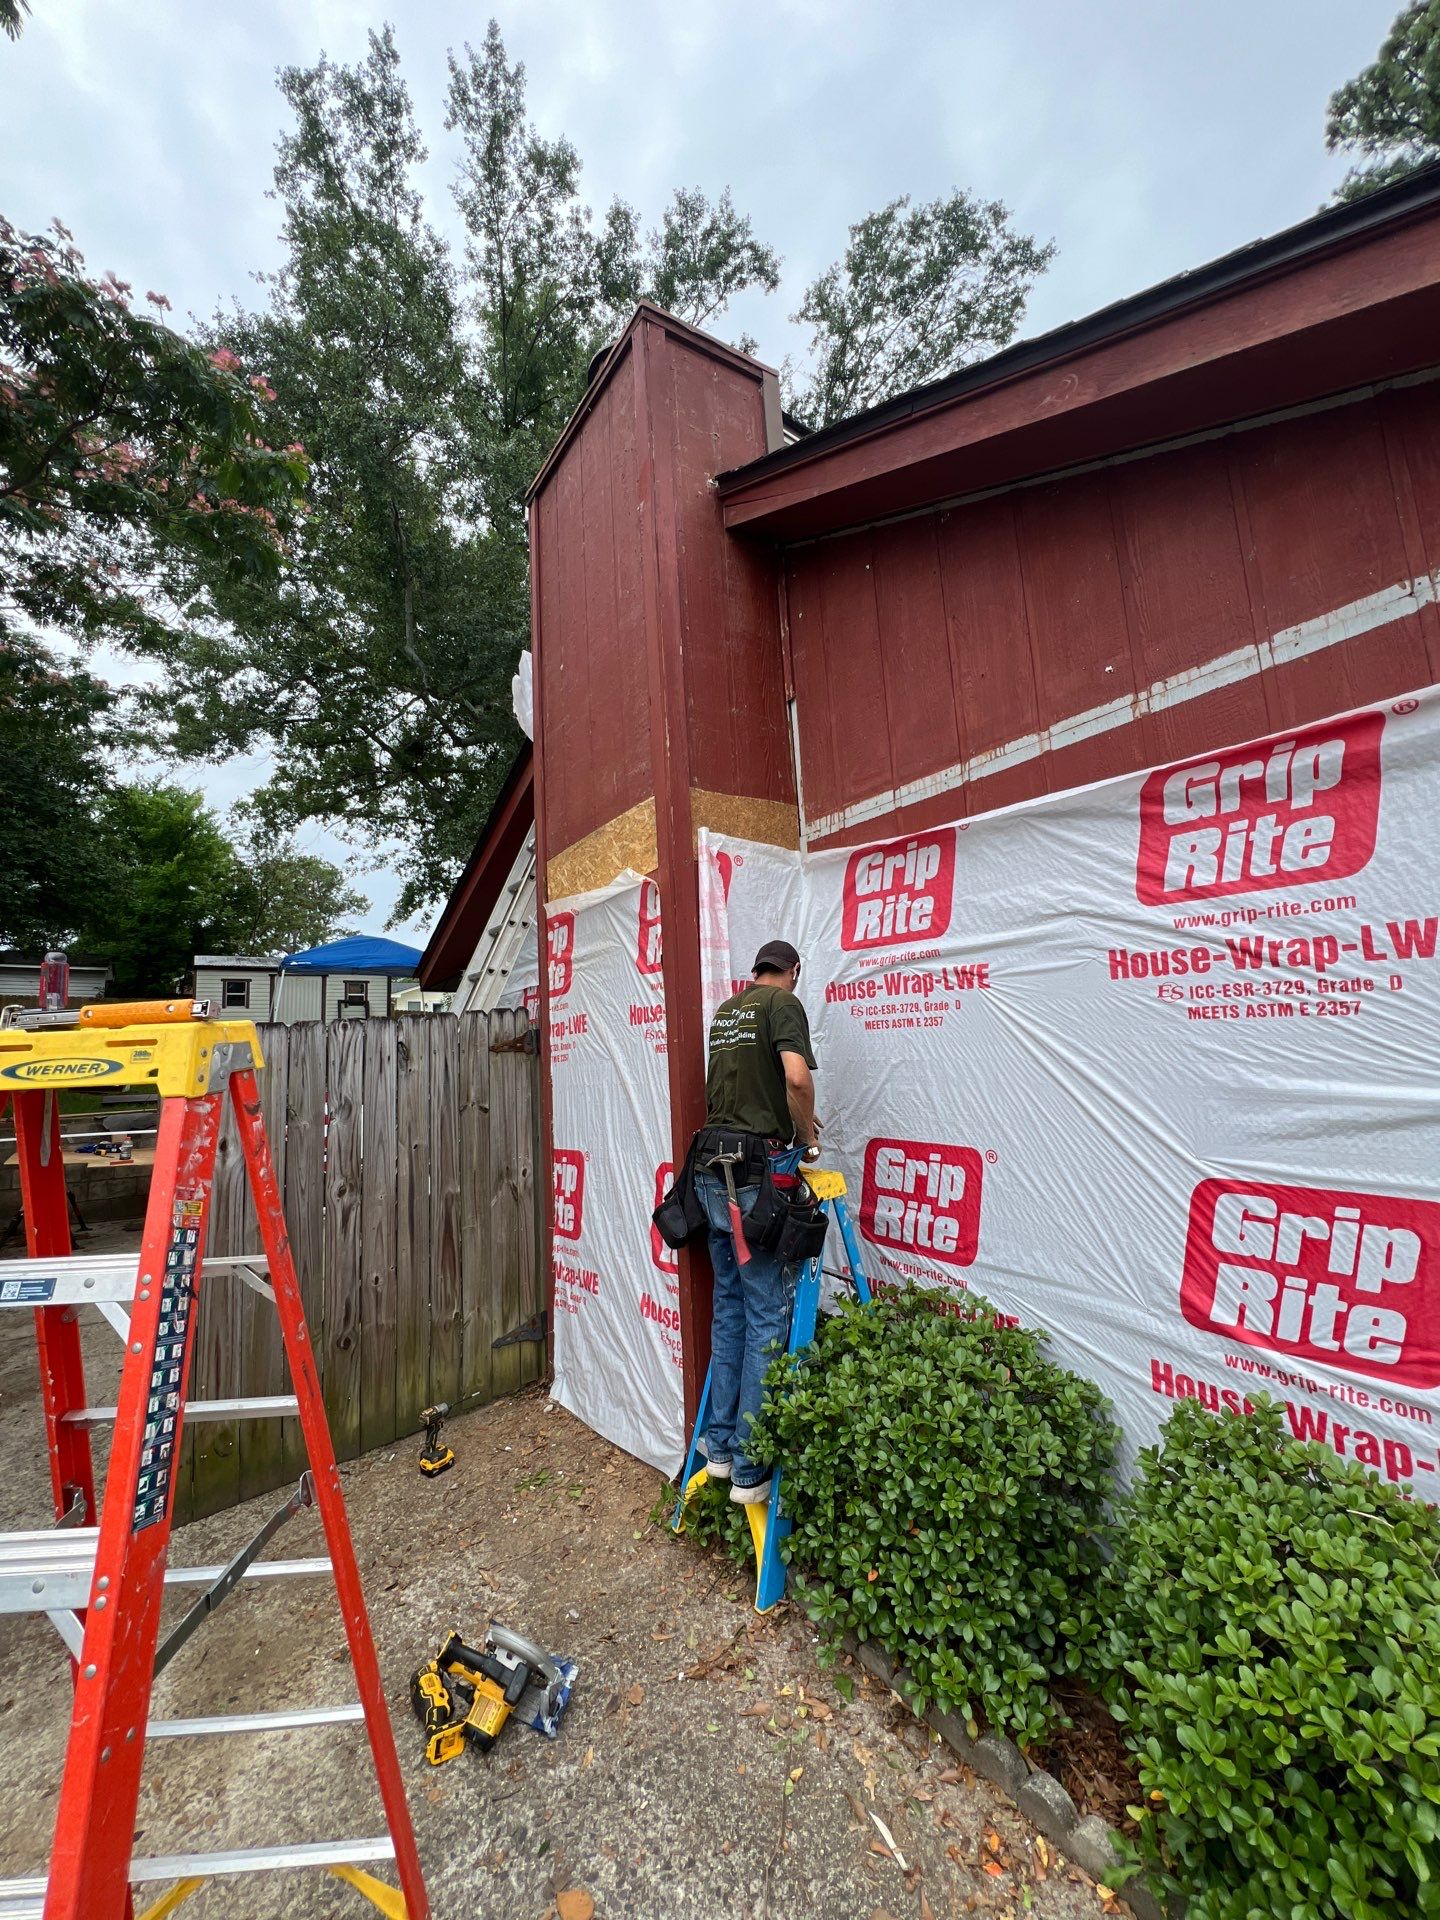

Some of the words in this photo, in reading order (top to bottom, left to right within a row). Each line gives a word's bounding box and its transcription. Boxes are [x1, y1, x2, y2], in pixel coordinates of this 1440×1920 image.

[1163, 739, 1346, 826] Grip
[855, 841, 940, 896] Grip
[1163, 813, 1336, 893] Rite
[853, 893, 934, 942] Rite
[1173, 895, 1357, 930] www.grip-rite.com
[548, 922, 568, 959] ip
[859, 949, 941, 968] www.grip-rite.com
[1108, 917, 1439, 980] House-Wrap-LW
[548, 960, 566, 991] te
[825, 963, 991, 1003] House-Wrap-LWE
[1189, 981, 1312, 999] ICC-ESR-3729,
[1317, 976, 1374, 993] Grade
[1389, 974, 1403, 991] D
[551, 1013, 588, 1040] rap-LWE
[864, 1019, 890, 1030] MEETS
[891, 1017, 914, 1028] ASTM
[916, 1016, 922, 1027] E
[923, 1016, 944, 1027] 2357
[865, 1004, 922, 1016] ICC-ESR-3729,
[924, 1002, 949, 1012] Grade
[955, 1000, 961, 1010] D
[1187, 1003, 1240, 1020] MEETS
[1246, 1003, 1294, 1018] ASTM
[1300, 1001, 1310, 1016] E
[1316, 1000, 1362, 1016] 2357
[26, 1062, 101, 1076] WERNER
[553, 1156, 578, 1197] rip
[874, 1147, 966, 1208] Grip
[874, 1194, 959, 1253] Rite
[1212, 1192, 1422, 1294] Grip
[879, 1255, 969, 1290] www.grip-rite.com
[1209, 1262, 1407, 1365] Rite
[1224, 1353, 1433, 1425] www.grip-rite.com
